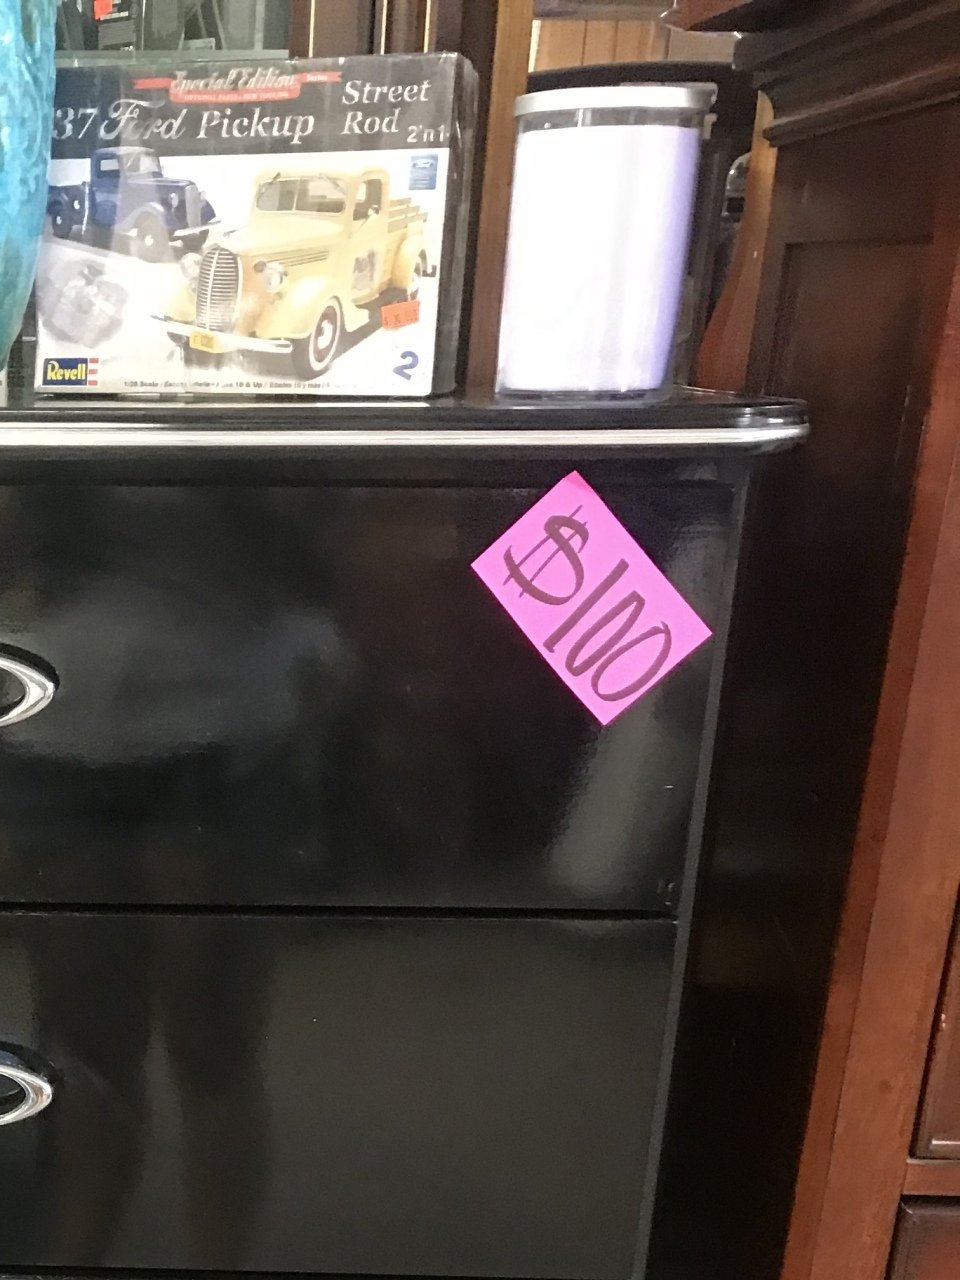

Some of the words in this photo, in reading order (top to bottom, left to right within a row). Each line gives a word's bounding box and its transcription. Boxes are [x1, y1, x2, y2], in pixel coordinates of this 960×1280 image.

[341, 79, 431, 105] Street
[195, 106, 315, 145] Pickup
[340, 107, 401, 135] Rod
[46, 360, 87, 381] Revell
[391, 350, 420, 381] 2
[503, 505, 672, 702] $100
